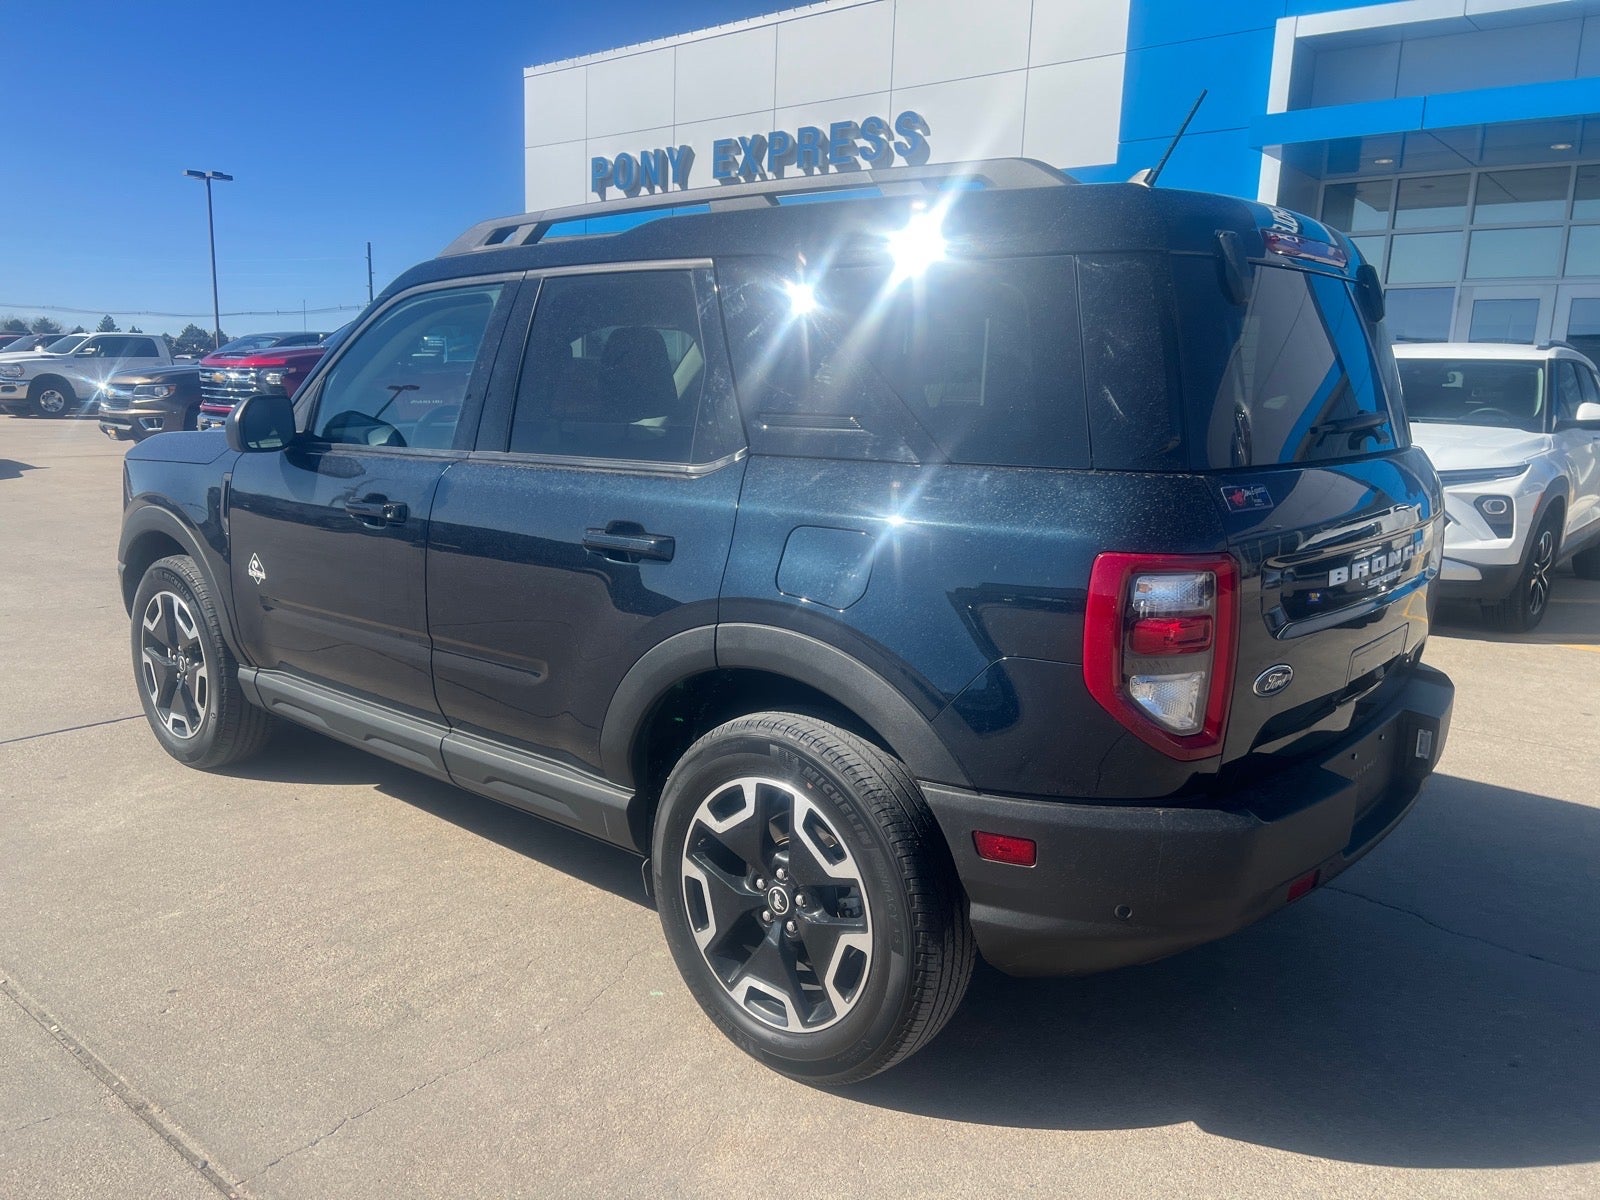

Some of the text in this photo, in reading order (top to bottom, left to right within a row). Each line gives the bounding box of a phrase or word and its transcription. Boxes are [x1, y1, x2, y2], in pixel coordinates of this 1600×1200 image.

[591, 111, 930, 197] PONY EXPRESS
[162, 572, 191, 602] MICHELIN
[1328, 541, 1424, 587] BRONCO
[1366, 568, 1403, 589] SPORT
[801, 765, 874, 846] MICHELIN
